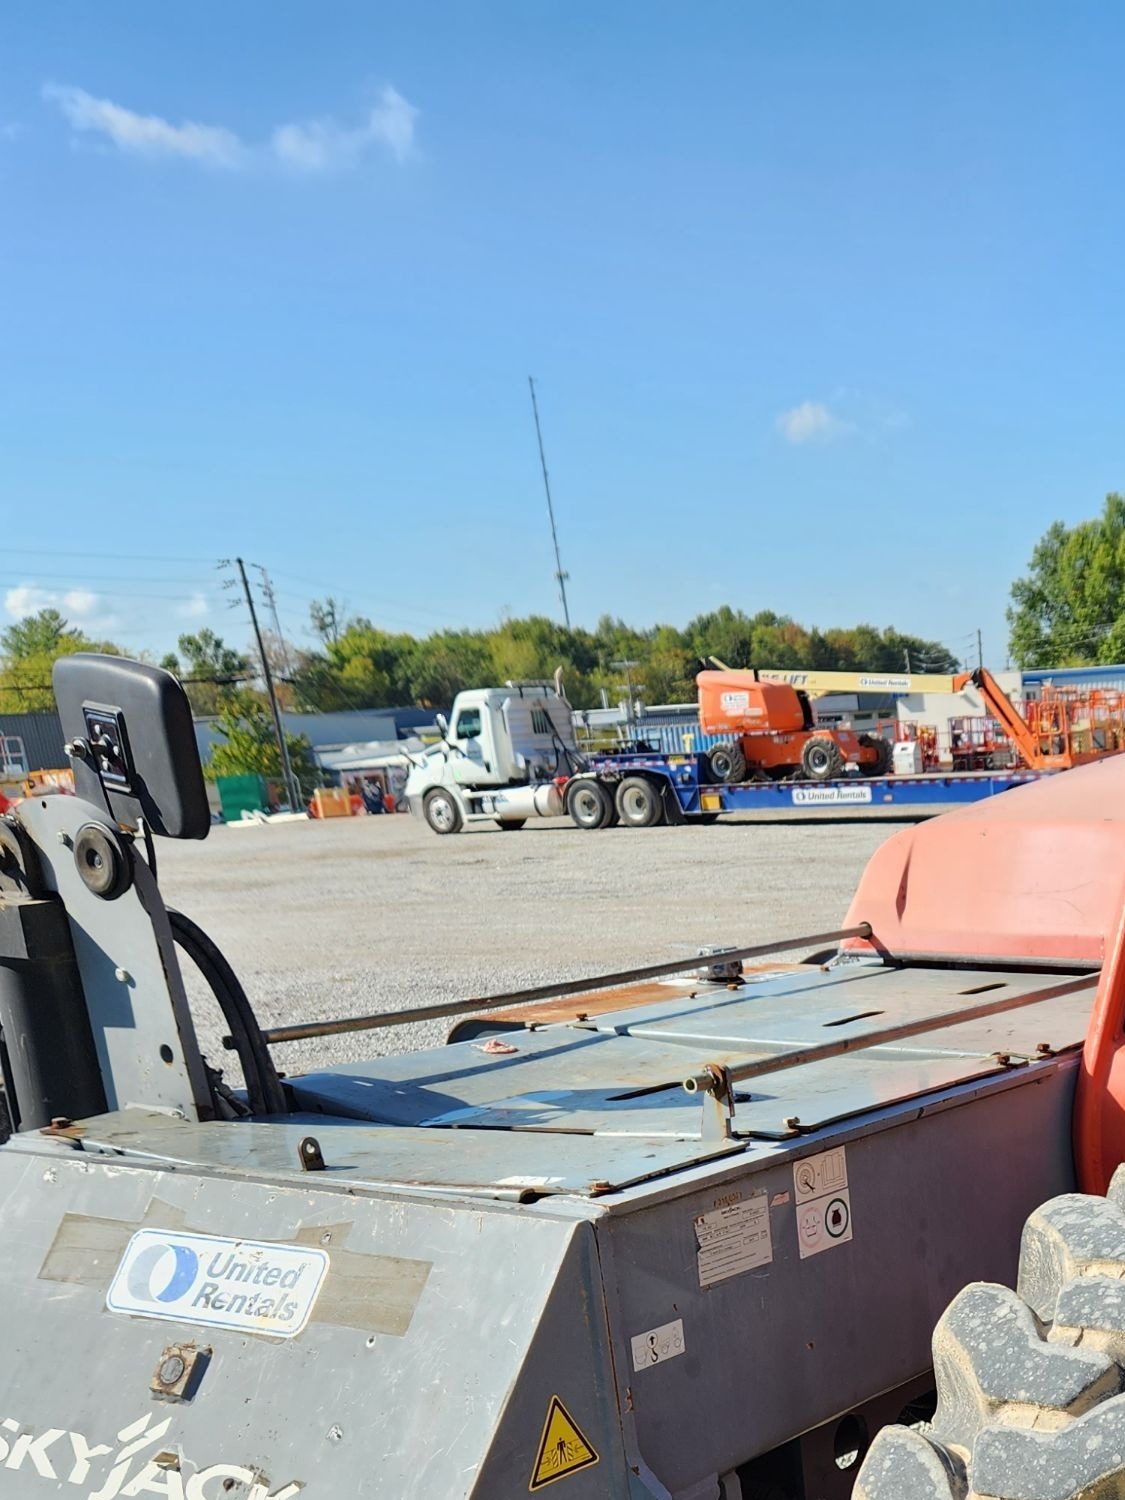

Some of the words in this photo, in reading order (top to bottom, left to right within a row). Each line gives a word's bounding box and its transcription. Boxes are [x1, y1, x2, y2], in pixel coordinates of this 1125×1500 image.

[808, 791, 834, 801] United
[836, 790, 867, 802] Rentals
[206, 1251, 304, 1289] United
[191, 1282, 299, 1321] Rentals
